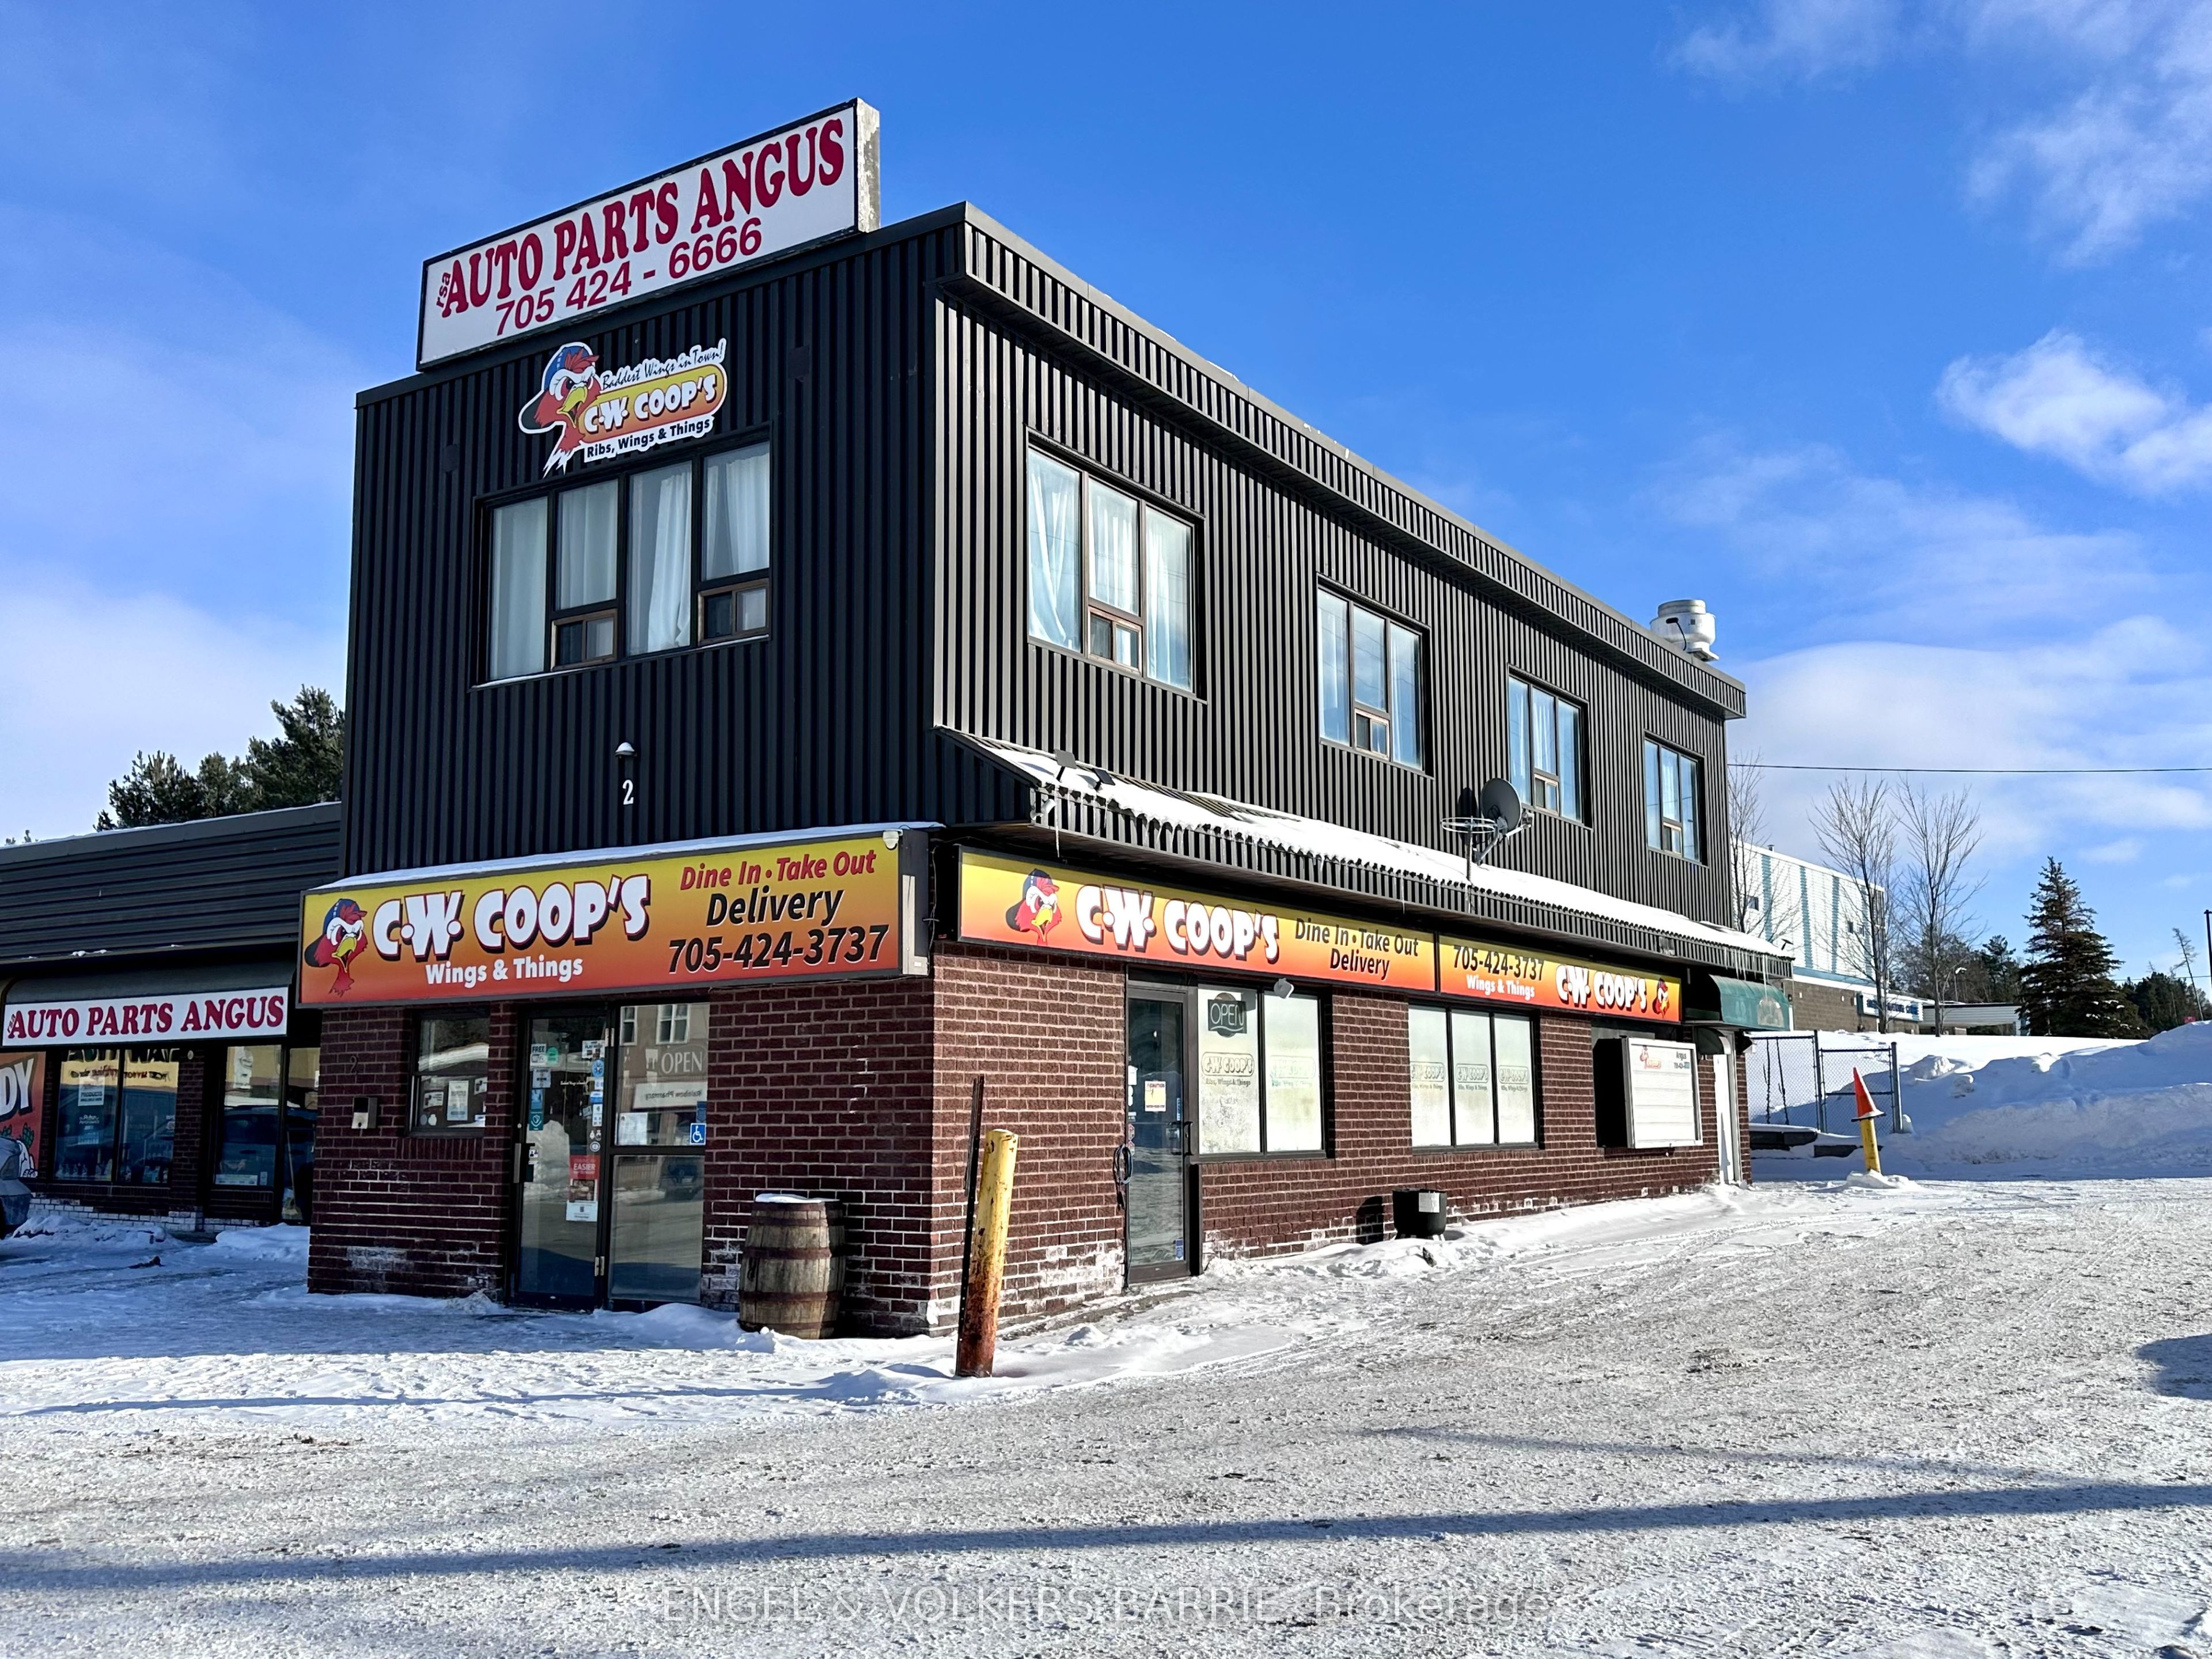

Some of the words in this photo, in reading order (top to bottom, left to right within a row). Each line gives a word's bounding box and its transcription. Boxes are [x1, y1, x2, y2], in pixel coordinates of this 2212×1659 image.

[442, 233, 543, 318] AUTO
[553, 183, 679, 281] PARTS
[691, 119, 843, 234] ANGUS
[436, 272, 451, 308] rsa
[496, 286, 555, 336] 705
[566, 268, 632, 310] 424
[669, 217, 762, 279] 6666
[603, 369, 640, 390] Baddest
[645, 362, 676, 378] Wings
[678, 355, 692, 368] in
[692, 342, 724, 365] Town!
[634, 373, 717, 421] COOP'S
[587, 443, 615, 459] Ribs,
[618, 433, 654, 450] Wings
[658, 428, 666, 440] &
[669, 419, 710, 437] Things
[622, 779, 634, 805] 2
[680, 862, 732, 891] Dine
[738, 861, 761, 884] In
[777, 854, 828, 882] Take
[834, 850, 877, 876] Out
[473, 873, 652, 955] COOP'S
[706, 885, 844, 927] Delivery
[669, 924, 890, 975] 705-424-3737
[1163, 898, 1280, 964] COOP'S
[1295, 917, 1330, 944] Dine
[1335, 925, 1349, 946] In
[1359, 928, 1390, 953] Take
[1394, 934, 1419, 957] Out
[426, 961, 487, 989] Wings
[493, 959, 509, 980] &
[513, 955, 584, 983] Things
[1330, 948, 1390, 980] Delivery
[1453, 945, 1545, 982] 705-424-3737
[1466, 974, 1496, 996] Wings
[1498, 978, 1505, 994] &
[1506, 980, 1535, 1001] Things
[1593, 971, 1647, 1013] COOP'S
[8, 1008, 79, 1039] AUTO
[86, 1002, 173, 1036] PARTS
[181, 996, 284, 1032] ANGUS
[1210, 1003, 1245, 1027] OPEN
[532, 1046, 546, 1054] FREE
[661, 1051, 703, 1074] OPEN
[573, 1163, 596, 1172] EASIER
